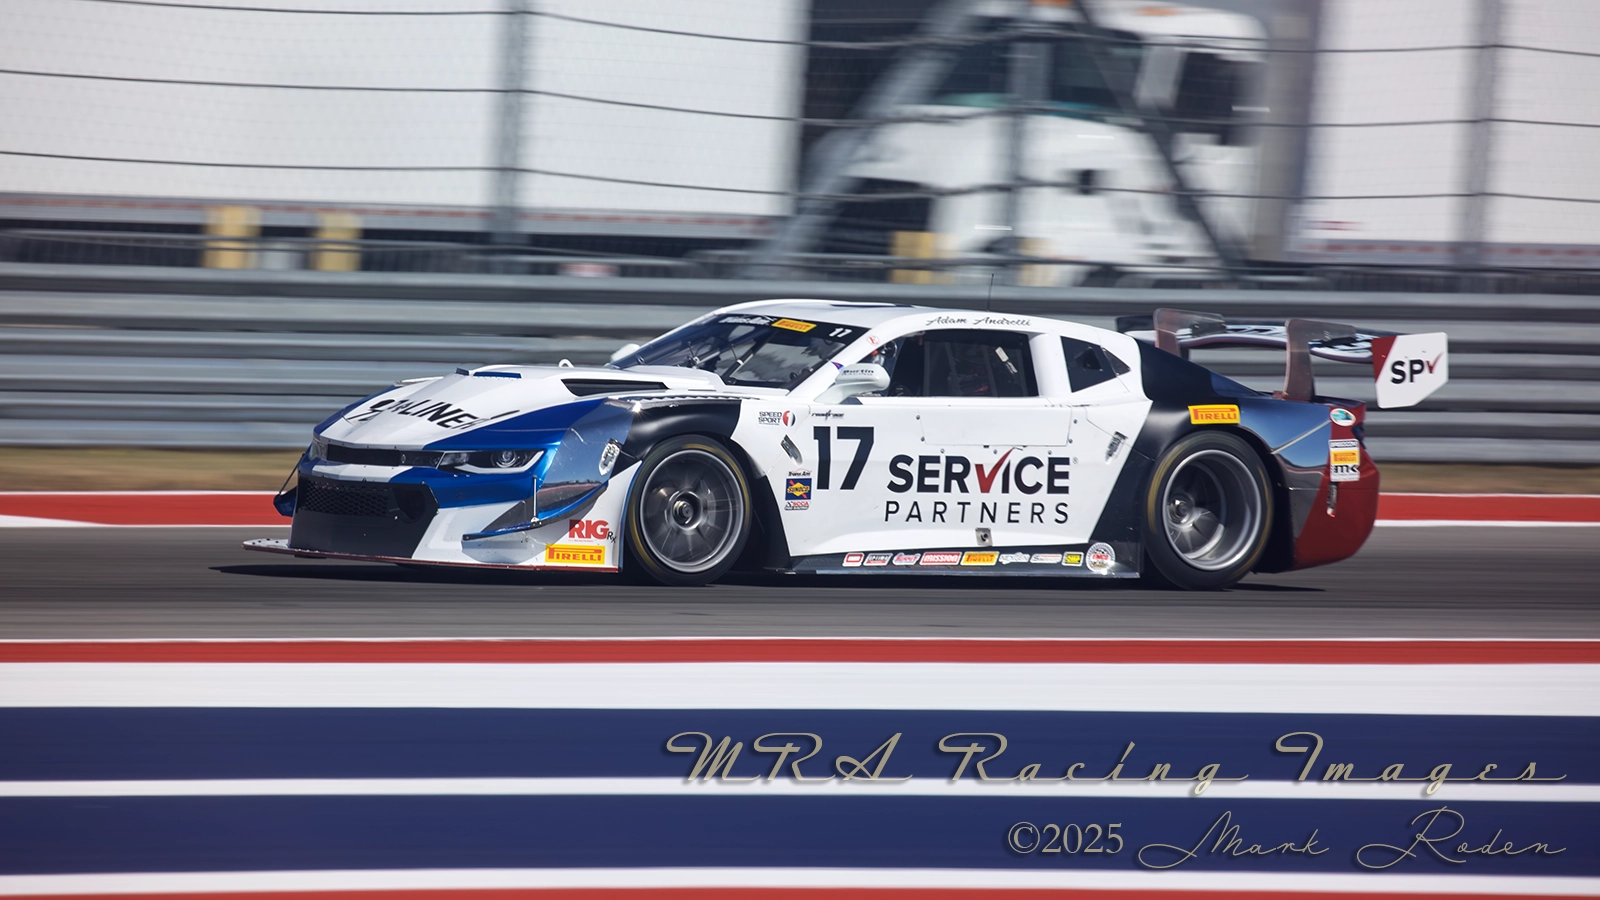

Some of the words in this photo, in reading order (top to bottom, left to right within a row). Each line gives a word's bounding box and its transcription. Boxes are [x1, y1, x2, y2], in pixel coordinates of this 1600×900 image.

[925, 316, 967, 326] Adam
[758, 416, 781, 424] SPORT
[1192, 408, 1237, 420] PIRELLI
[813, 426, 874, 490] 17
[887, 446, 1069, 494] SERVICE
[884, 501, 1068, 524] PARTNERS
[568, 519, 610, 541] RIG
[548, 547, 603, 561] PIRELLI
[964, 554, 996, 564] PIRELLI
